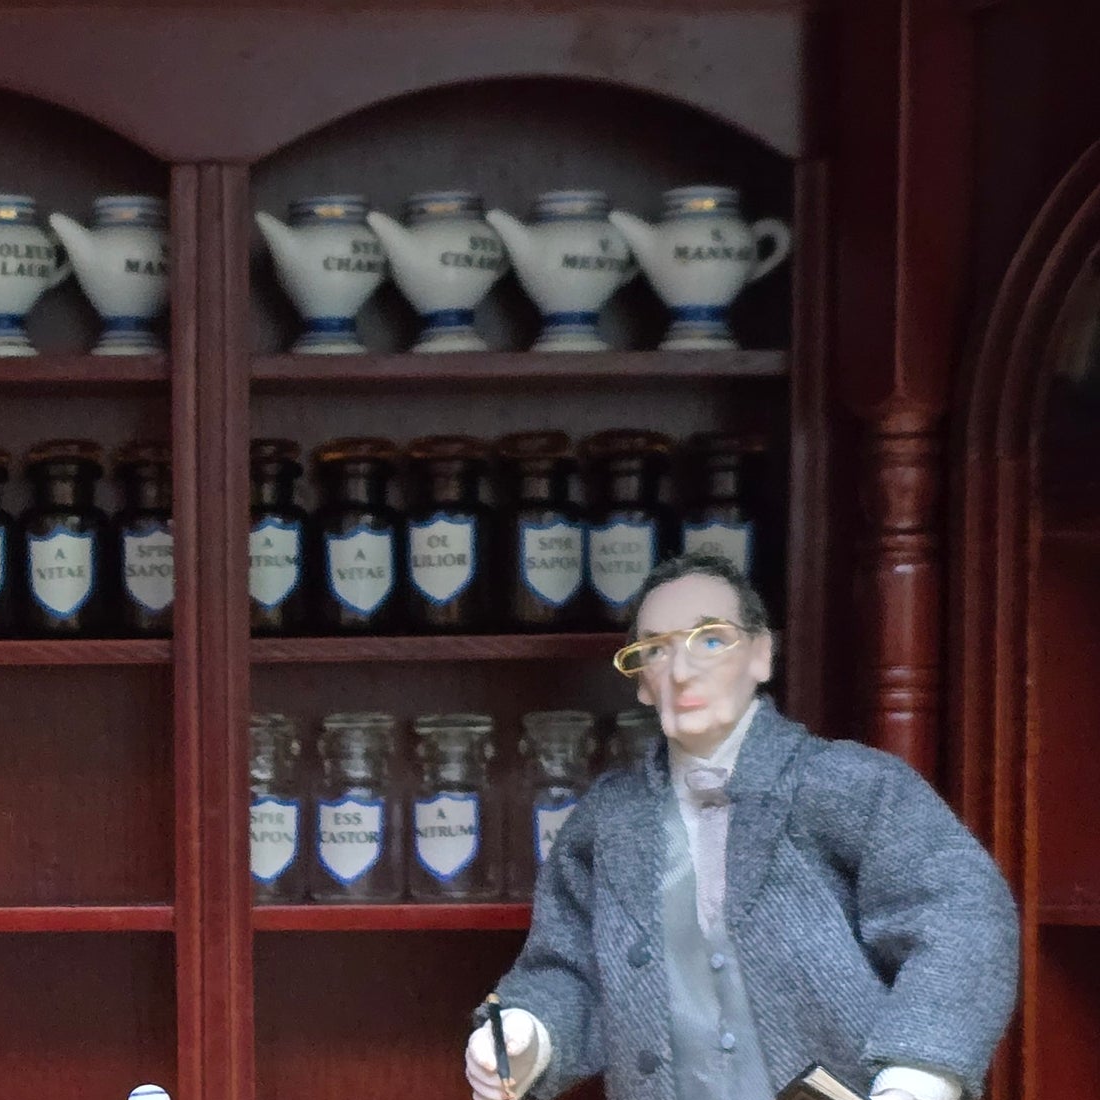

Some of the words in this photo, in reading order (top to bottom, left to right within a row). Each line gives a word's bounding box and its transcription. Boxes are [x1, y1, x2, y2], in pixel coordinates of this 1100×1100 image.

[54, 548, 65, 560] A
[354, 549, 366, 561] A
[333, 812, 364, 826] ESS
[435, 808, 447, 820] A
